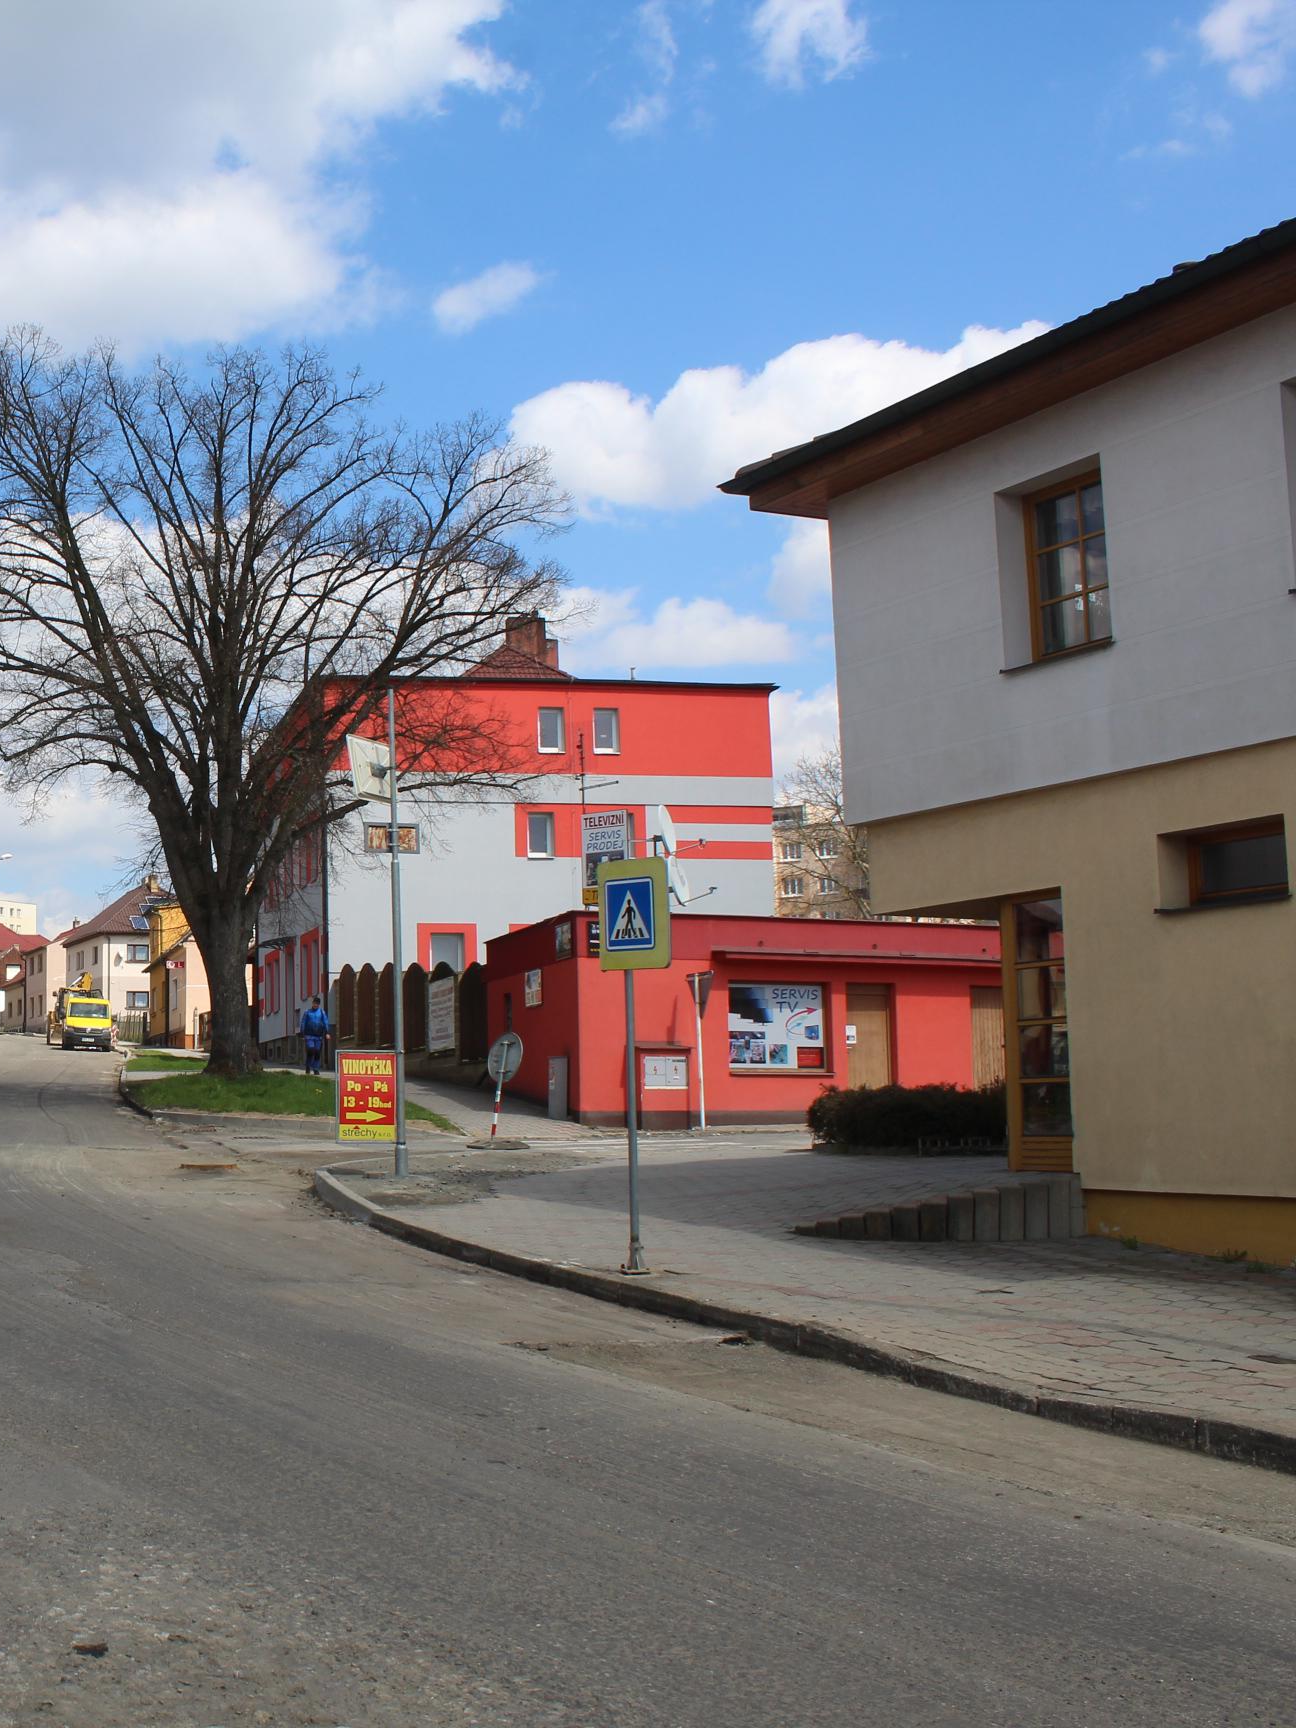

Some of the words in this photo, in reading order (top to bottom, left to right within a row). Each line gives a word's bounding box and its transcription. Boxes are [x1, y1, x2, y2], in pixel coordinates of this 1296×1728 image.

[584, 811, 624, 828] TELEVIZNÍ
[589, 830, 621, 841] SERVIS
[586, 841, 624, 851] PRODEJ
[772, 988, 818, 999] SERVIS
[776, 1001, 798, 1013] TV
[342, 1057, 392, 1074] VINOTÉKA
[347, 1080, 361, 1092] Po
[373, 1081, 388, 1092] Pá
[343, 1096, 355, 1107] 13
